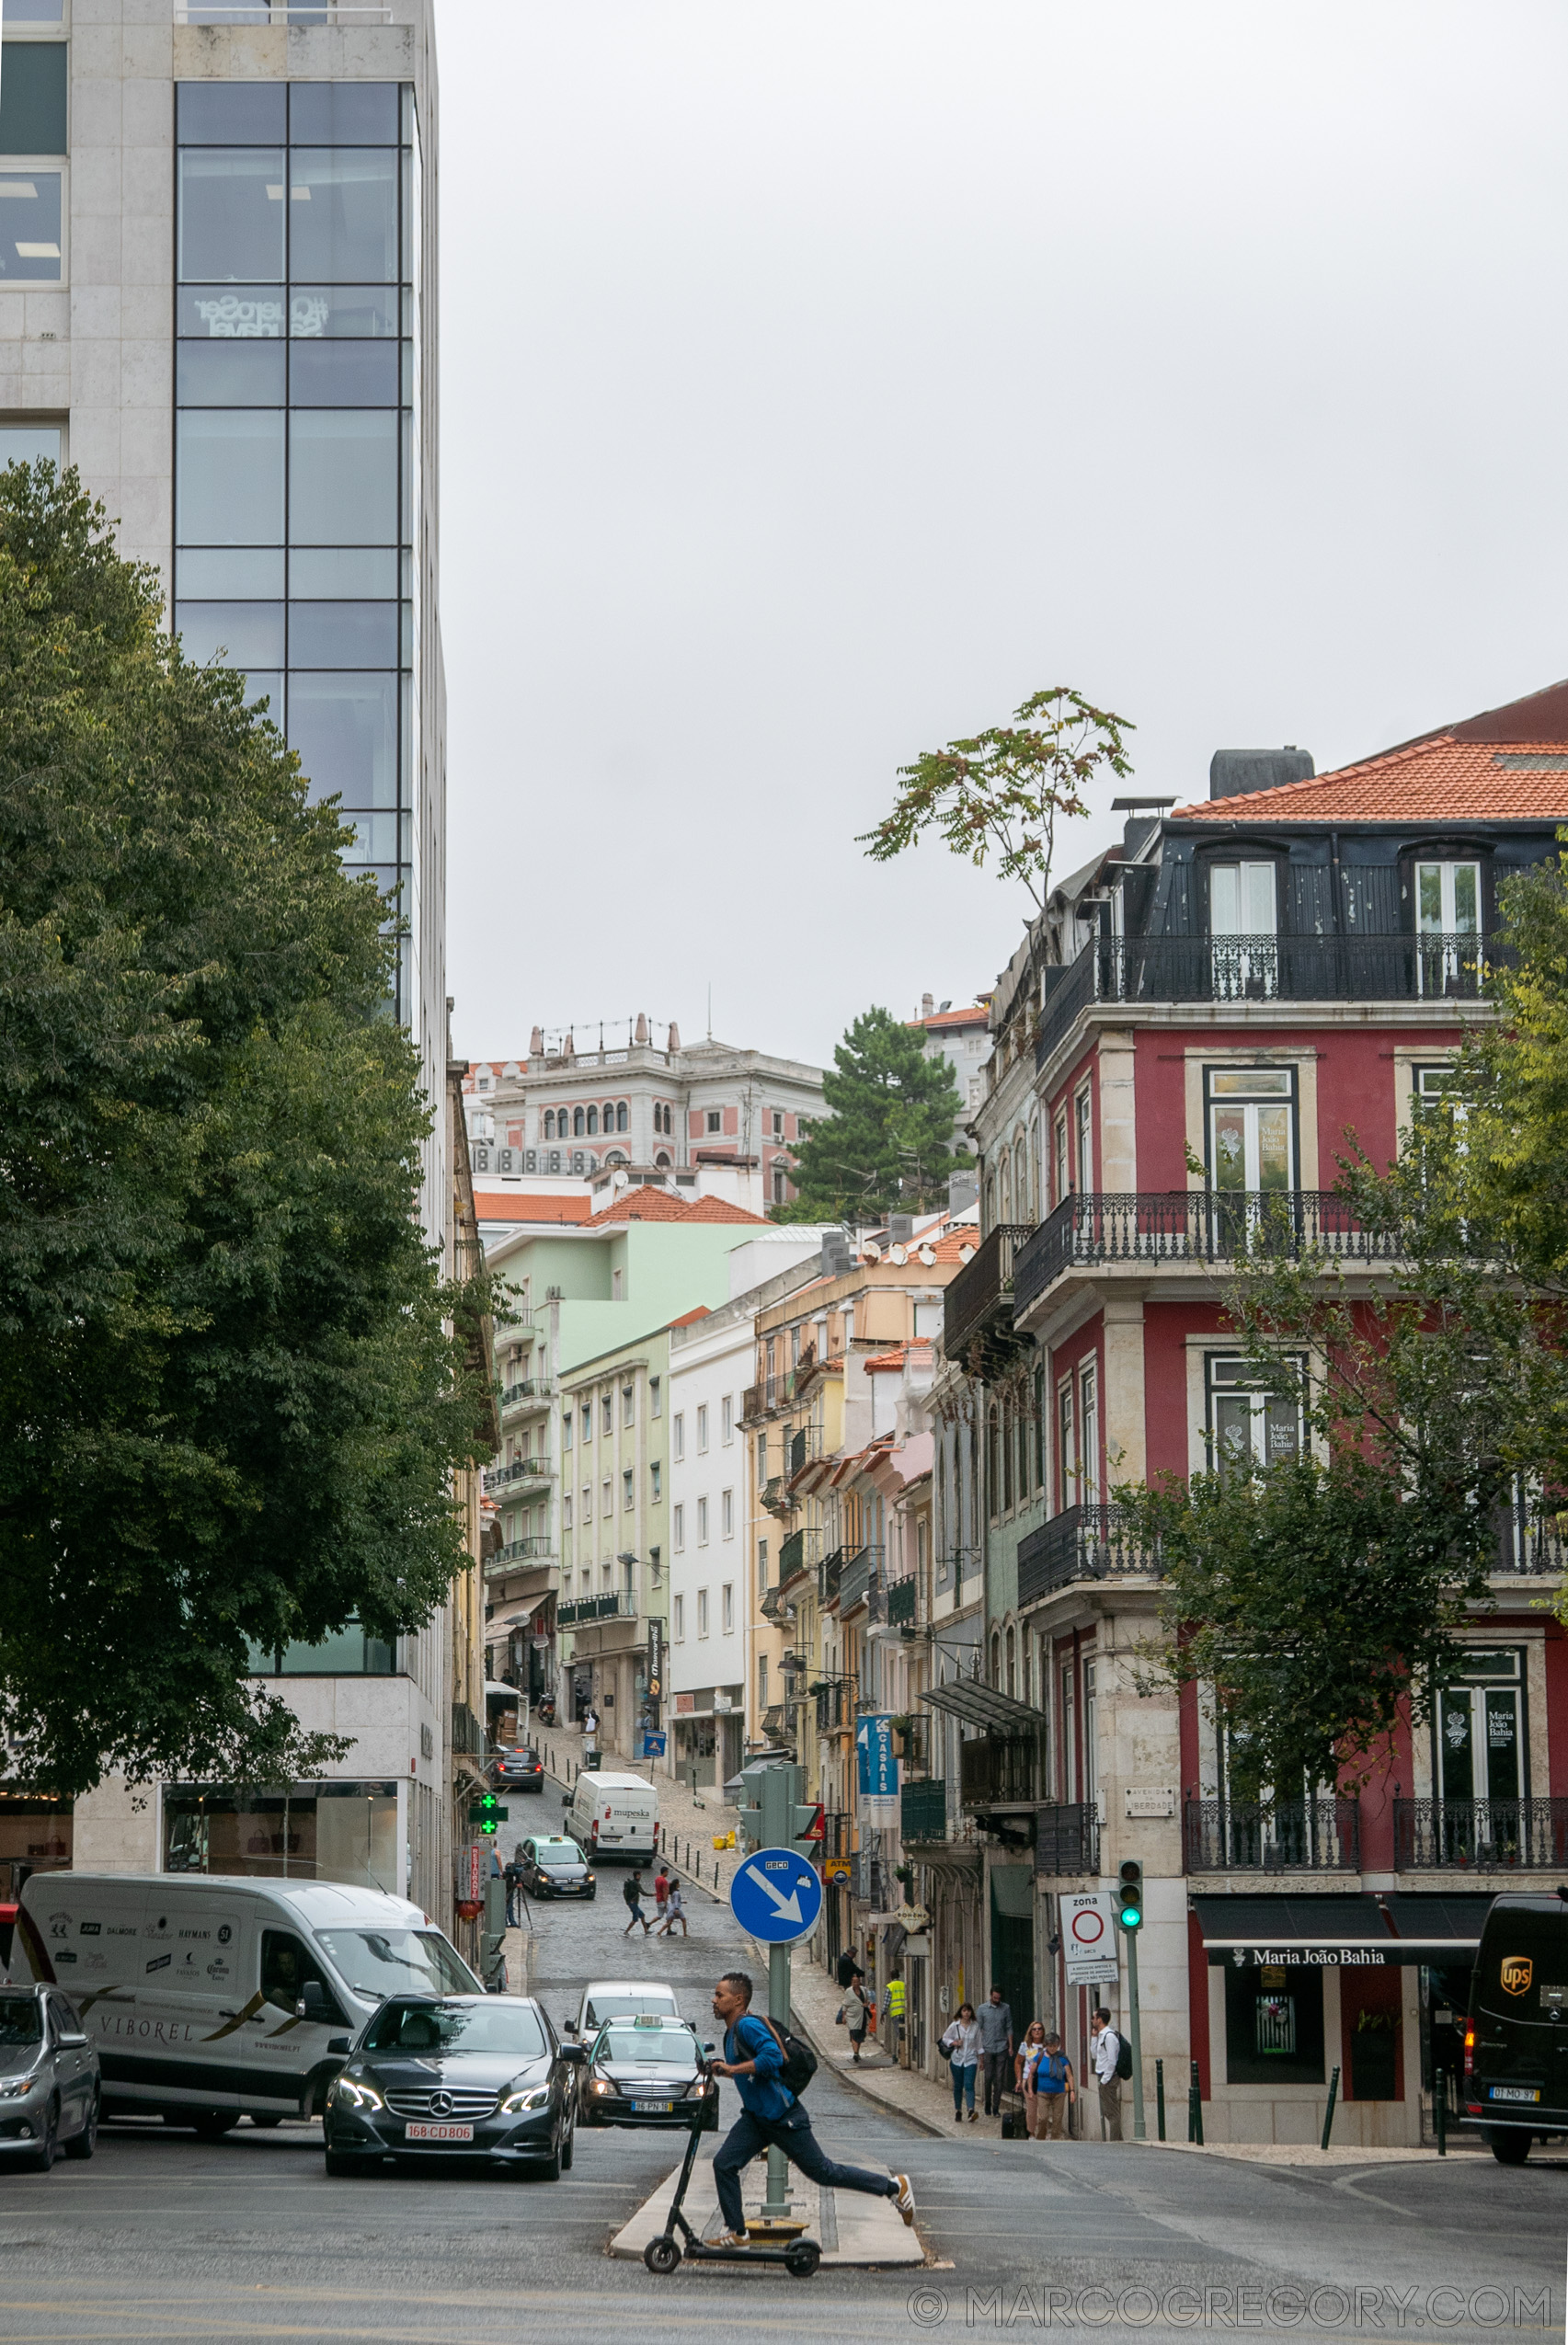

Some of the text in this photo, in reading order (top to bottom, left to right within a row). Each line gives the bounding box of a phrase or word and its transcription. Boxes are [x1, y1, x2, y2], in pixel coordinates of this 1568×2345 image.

[1270, 1424, 1295, 1432] Maria
[1271, 1440, 1294, 1448] Bahia
[1489, 1711, 1514, 1720] Maria
[1489, 1720, 1507, 1728] João
[1489, 1728, 1513, 1736] Bahia
[878, 1733, 887, 1791] CASAIS
[613, 1809, 650, 1818] mupeska
[1073, 1897, 1098, 1906] zona
[1253, 1949, 1385, 1964] Maria João Bahia
[1504, 1968, 1529, 1990] ups
[101, 2016, 193, 2045] VIBOREL
